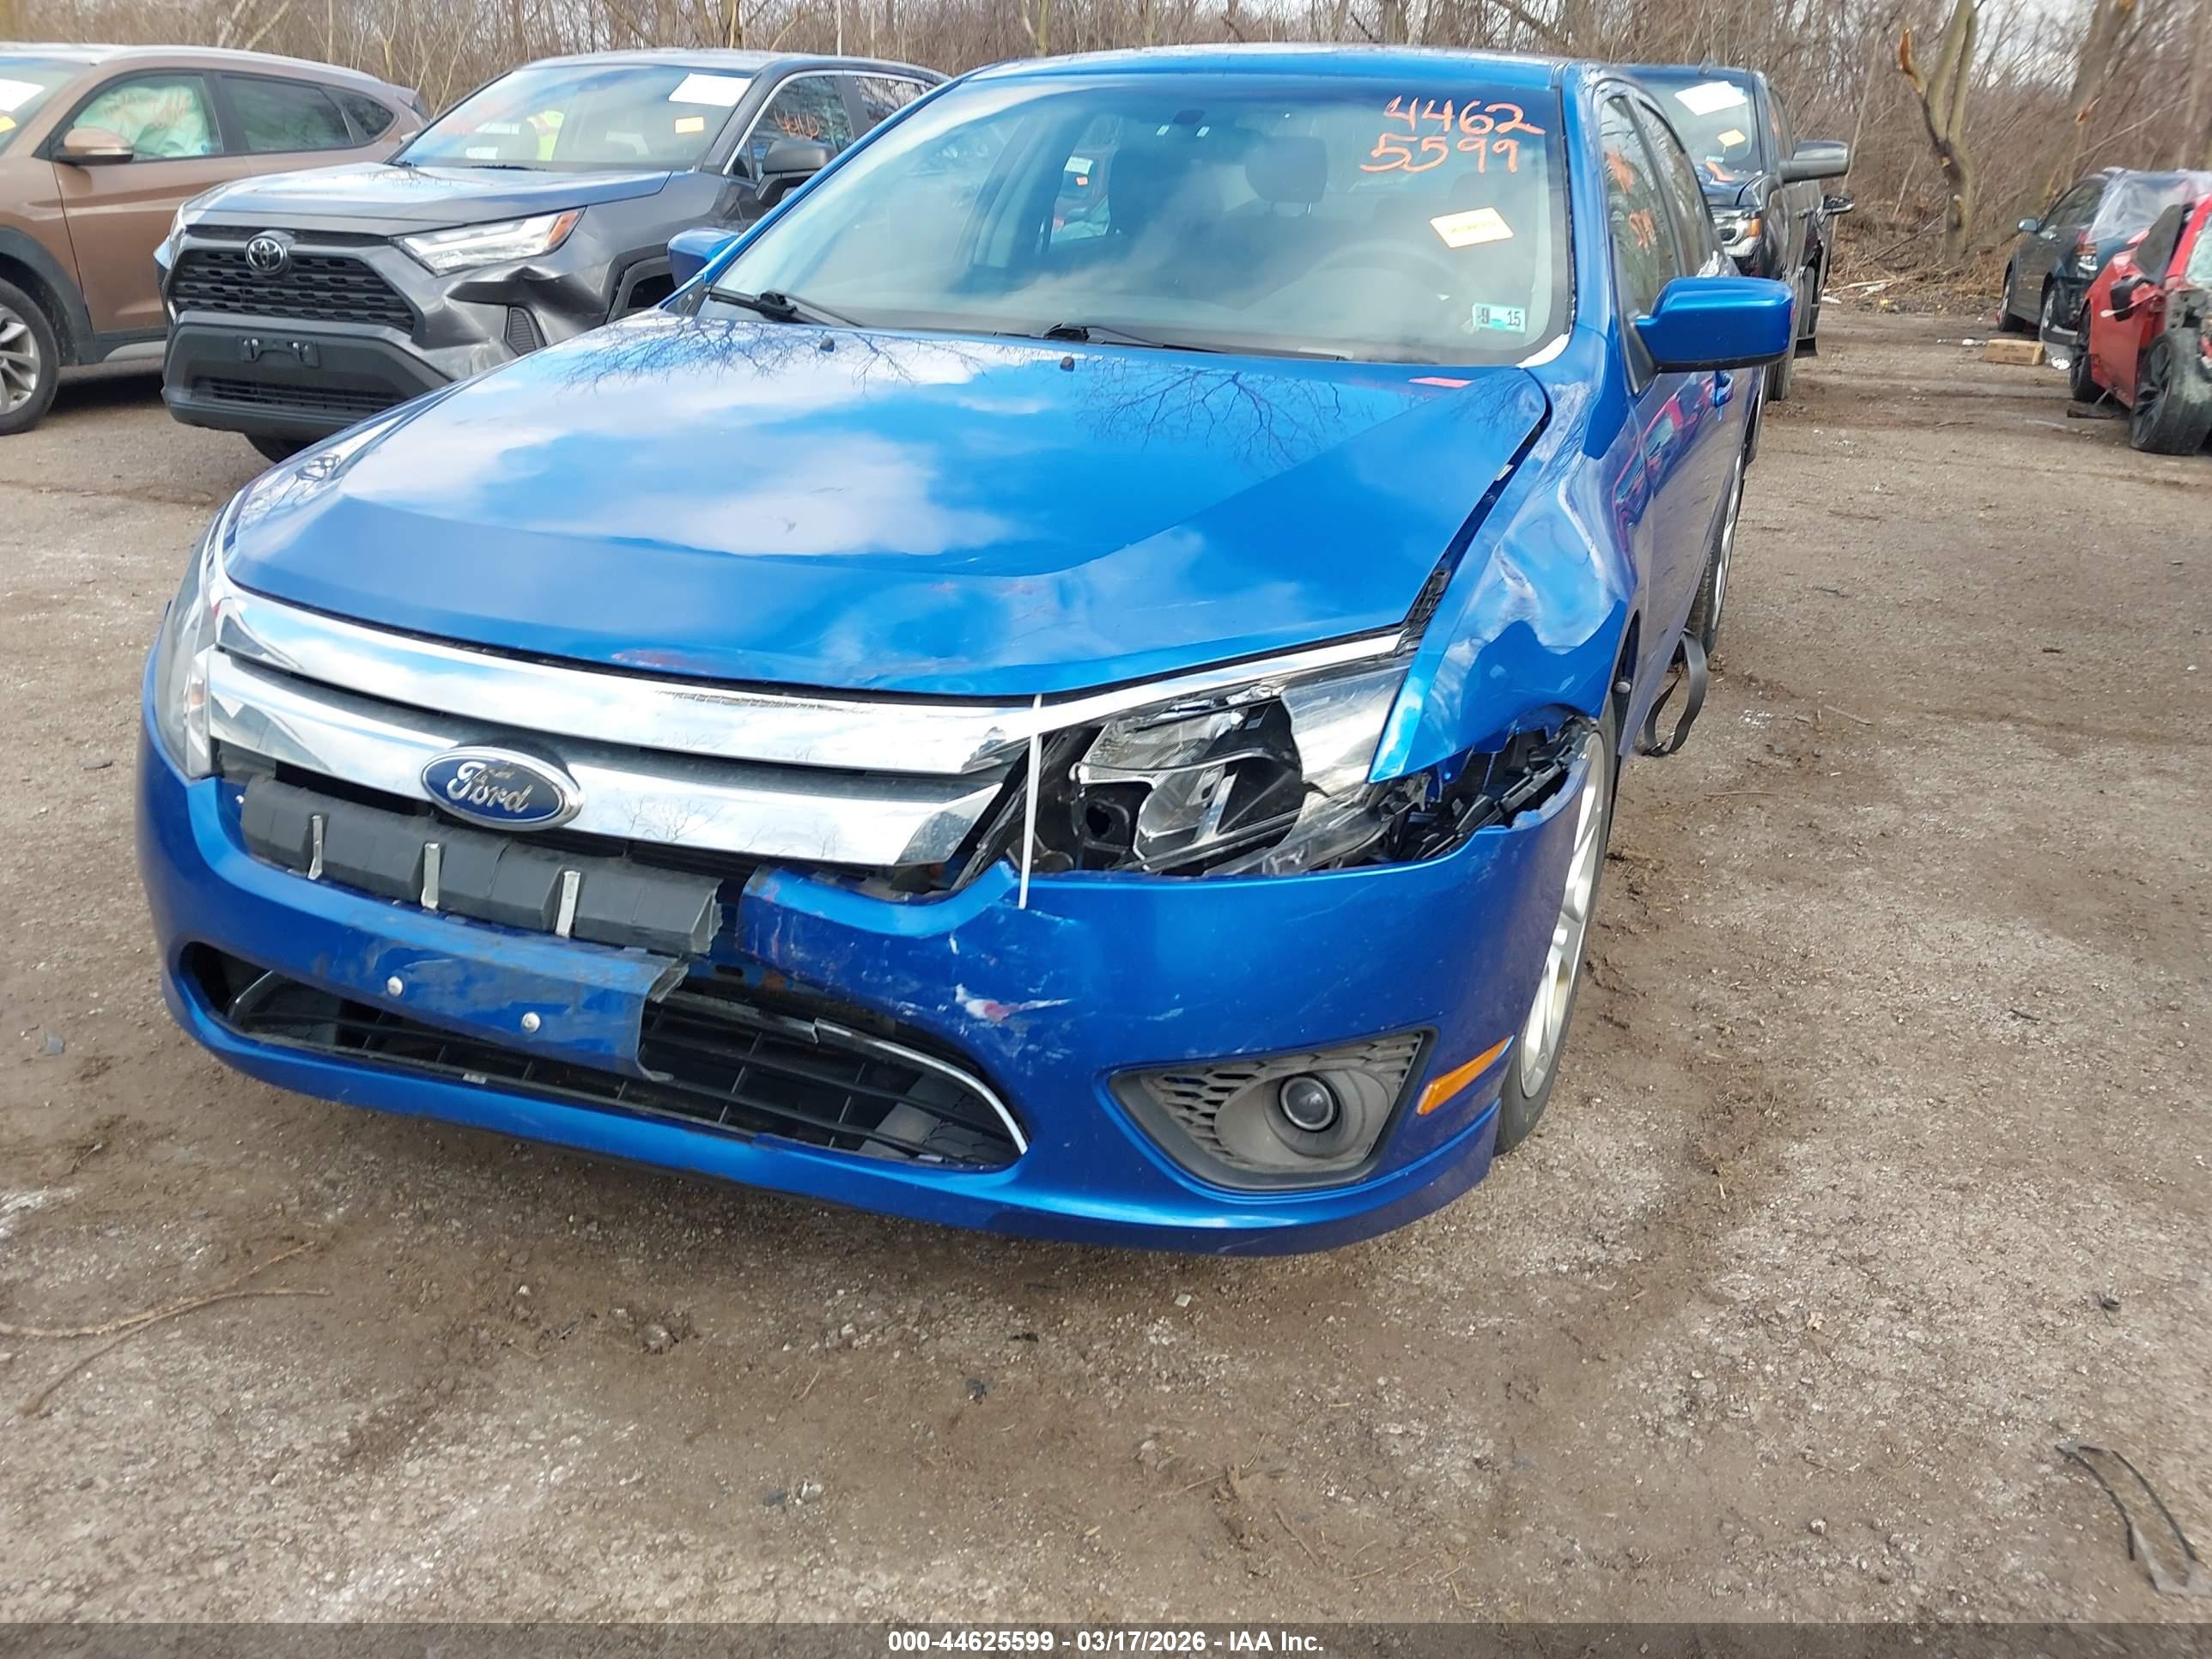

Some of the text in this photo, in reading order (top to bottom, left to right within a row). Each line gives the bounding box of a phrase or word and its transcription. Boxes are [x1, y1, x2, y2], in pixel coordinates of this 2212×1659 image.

[1382, 94, 1546, 135] 4462
[1359, 131, 1521, 173] 5599
[1507, 309, 1522, 327] 15
[447, 761, 534, 813] Ford
